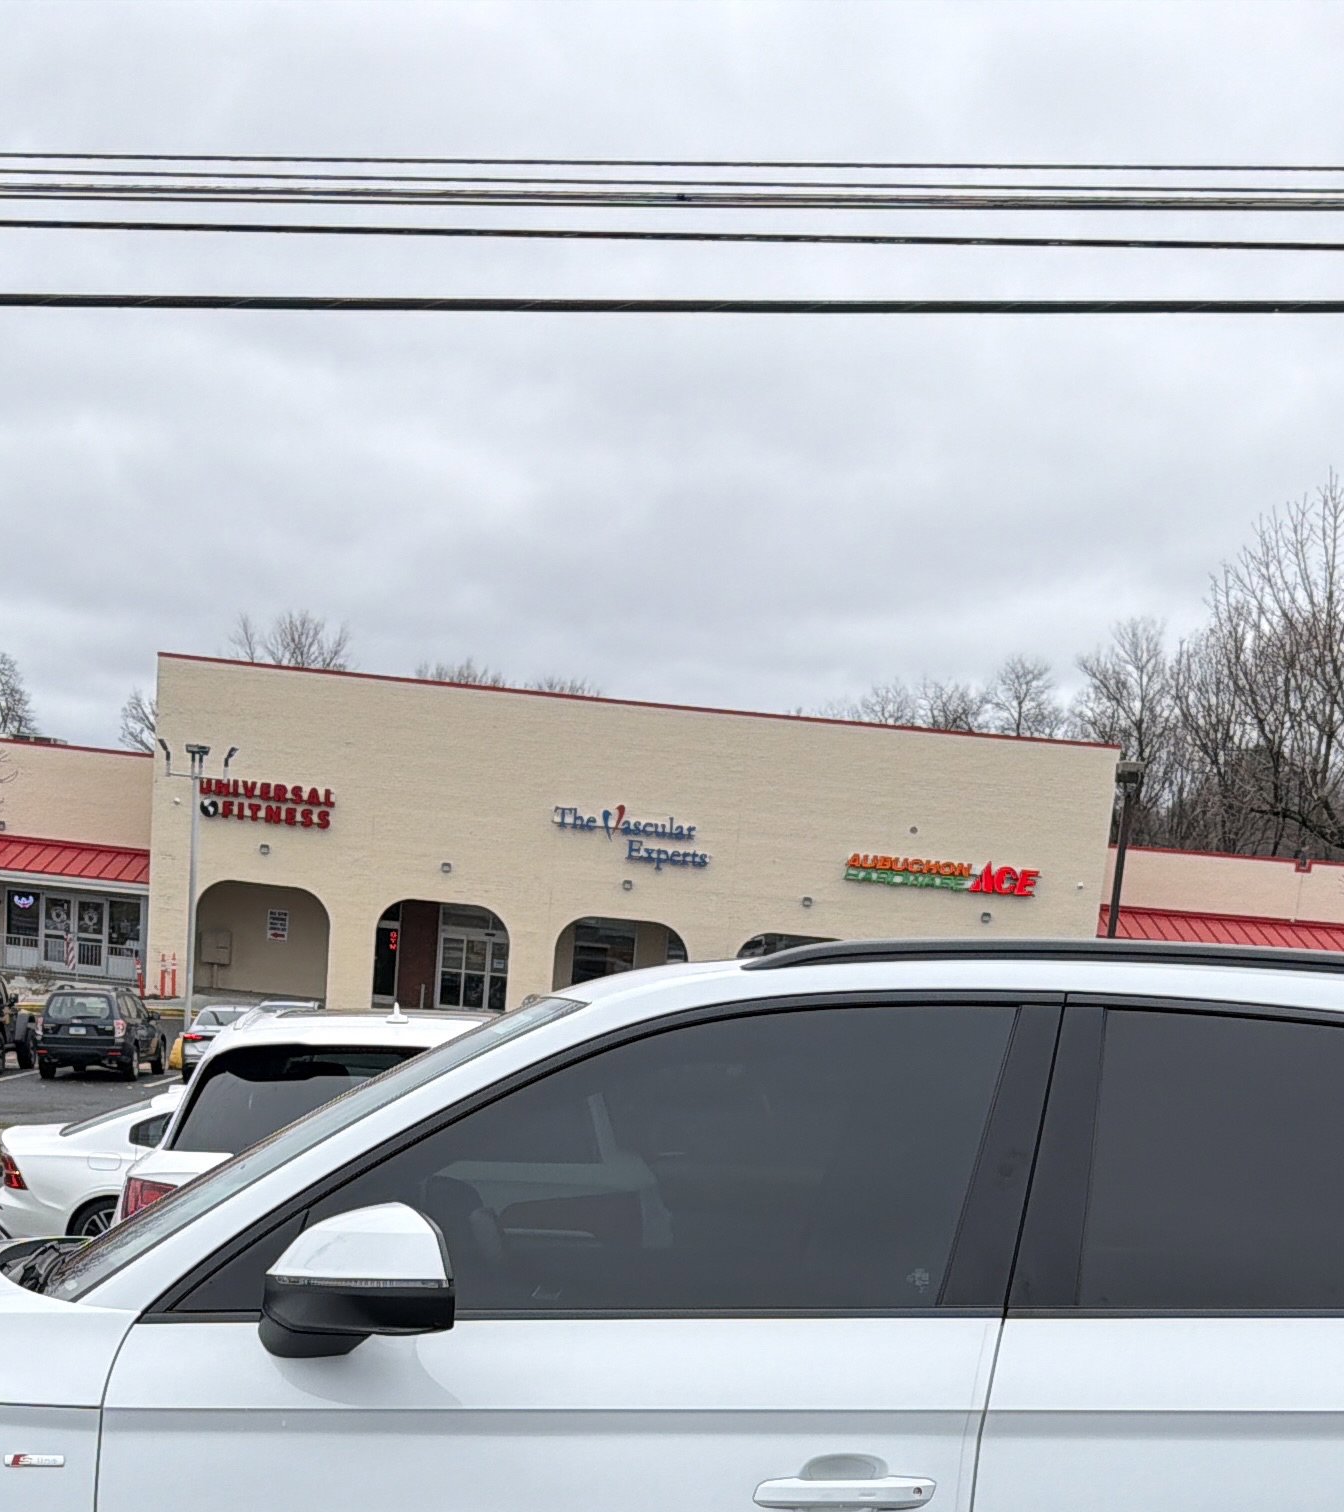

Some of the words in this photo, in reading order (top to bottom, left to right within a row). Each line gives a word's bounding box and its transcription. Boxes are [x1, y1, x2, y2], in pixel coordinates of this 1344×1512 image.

[199, 777, 335, 808] UNIVERSAL
[221, 800, 331, 830] FITNESS
[552, 805, 597, 829] The
[602, 804, 697, 841] Vascular
[626, 839, 711, 870] Experts
[846, 853, 974, 877] AUBUCHON
[968, 861, 1042, 897] ACE
